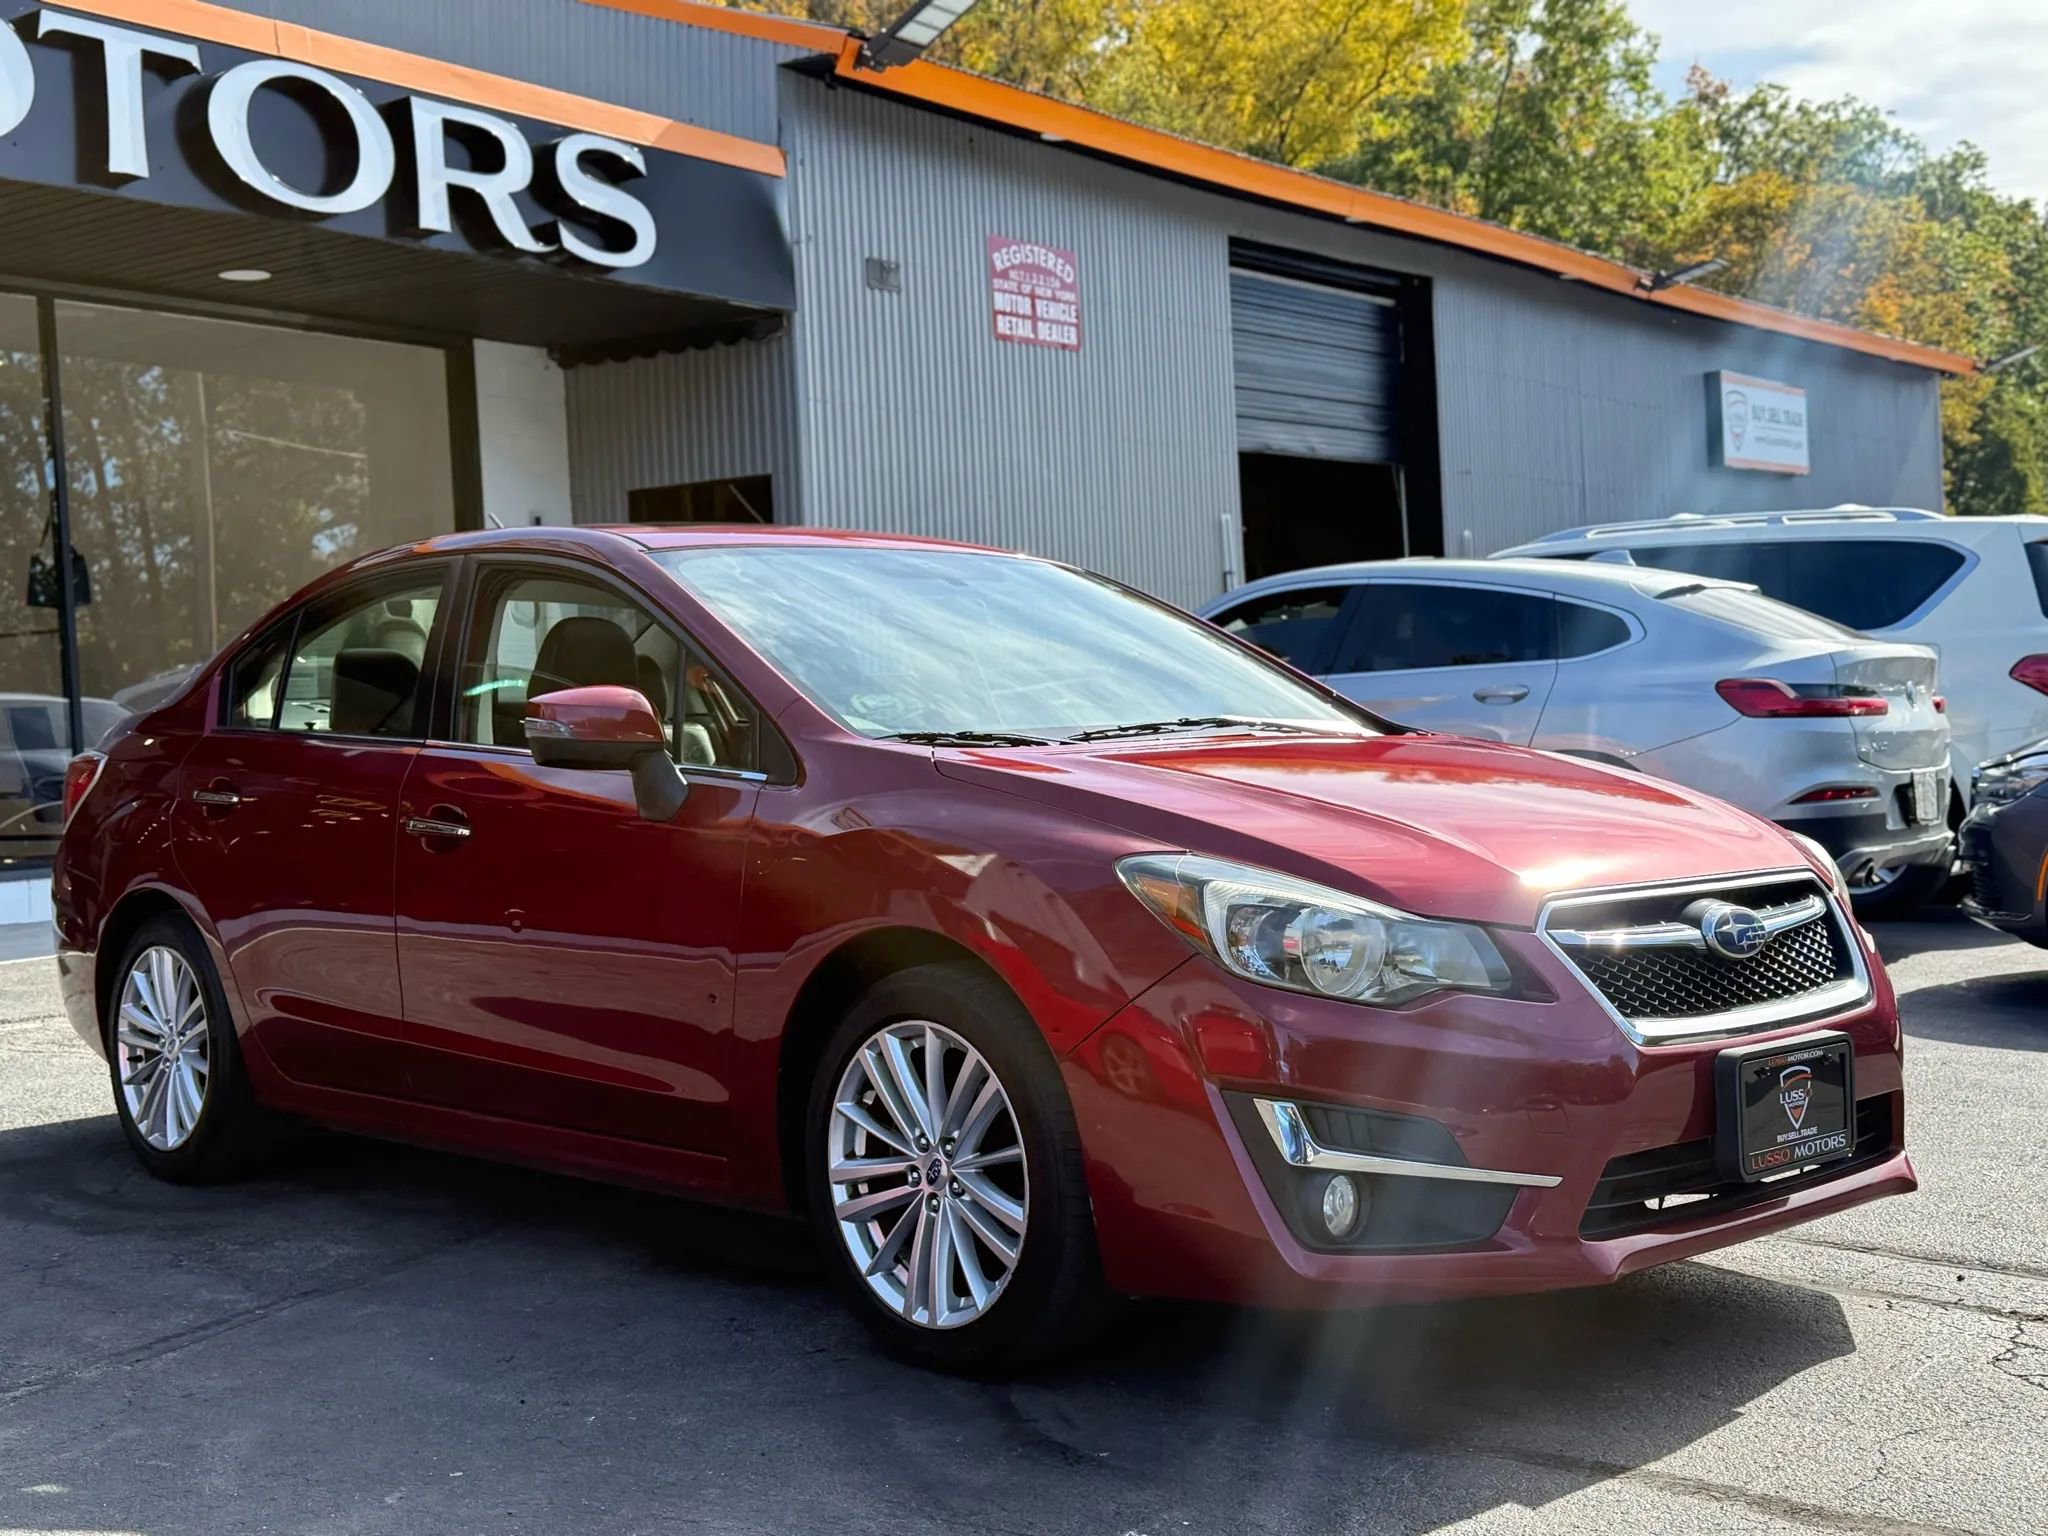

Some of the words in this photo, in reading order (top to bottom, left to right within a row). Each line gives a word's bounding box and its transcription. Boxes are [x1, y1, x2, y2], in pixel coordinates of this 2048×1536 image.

[0, 8, 657, 269] TORS
[992, 245, 1075, 283] REGISTERED
[993, 291, 1033, 316] MOTOR
[1034, 299, 1078, 323] VEHICLE
[996, 314, 1035, 338] RETAIL
[1037, 321, 1078, 344] DEALER
[1780, 1088, 1813, 1104] LUSSO
[1752, 1150, 1791, 1169] LUSSO
[1793, 1134, 1847, 1159] MOTORS
